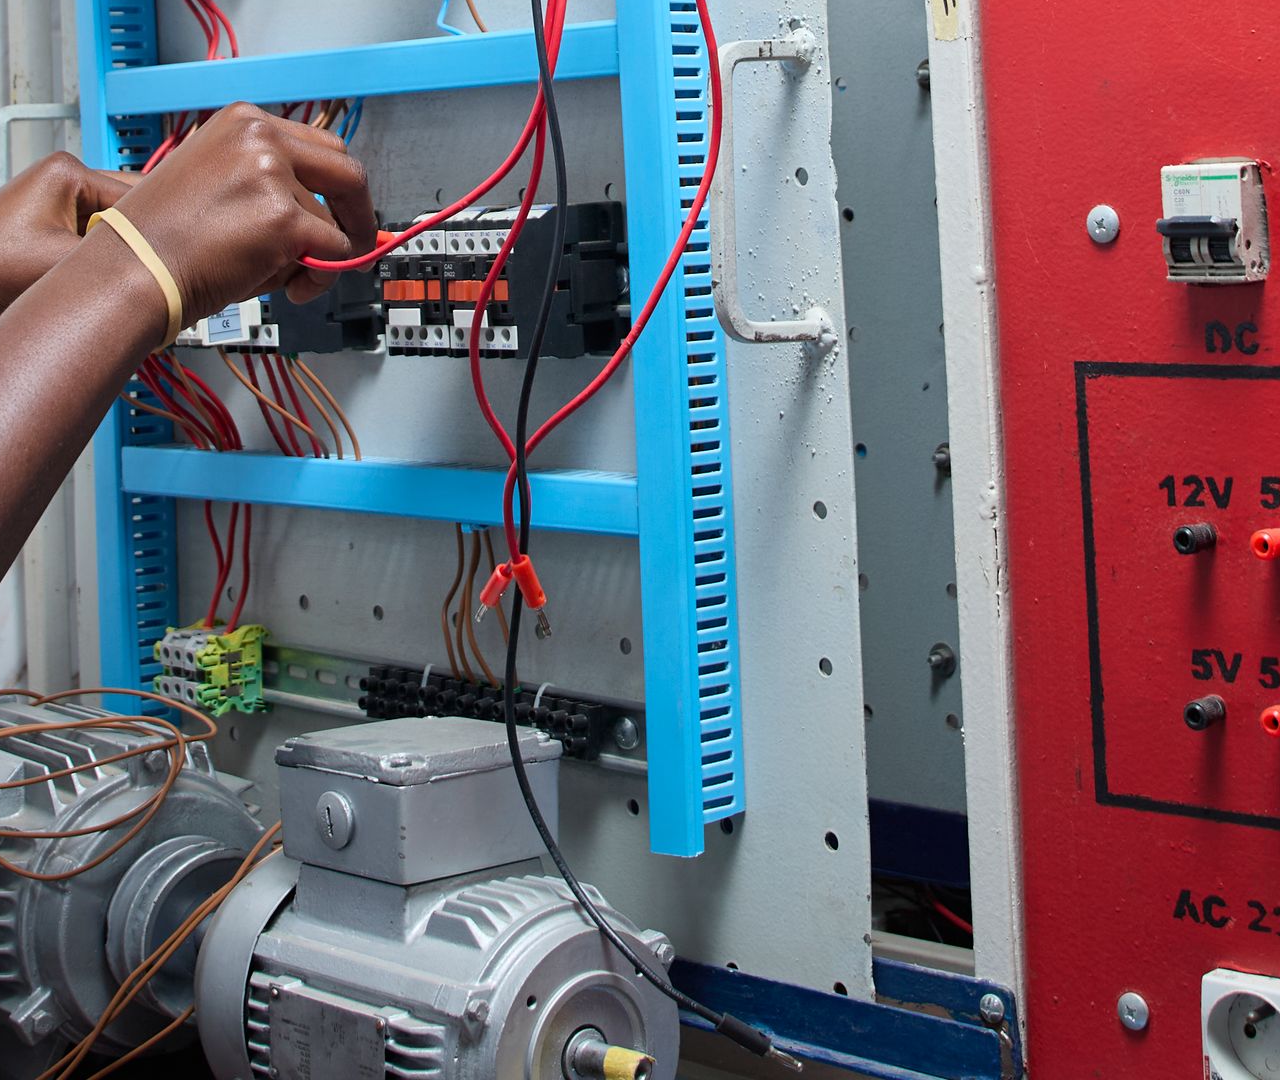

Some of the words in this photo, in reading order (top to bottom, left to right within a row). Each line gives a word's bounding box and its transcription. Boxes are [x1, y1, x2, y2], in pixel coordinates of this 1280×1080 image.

[1204, 322, 1260, 355] DC
[1158, 475, 1233, 510] 12V
[1191, 649, 1242, 683] 5V
[1173, 889, 1231, 928] AC
